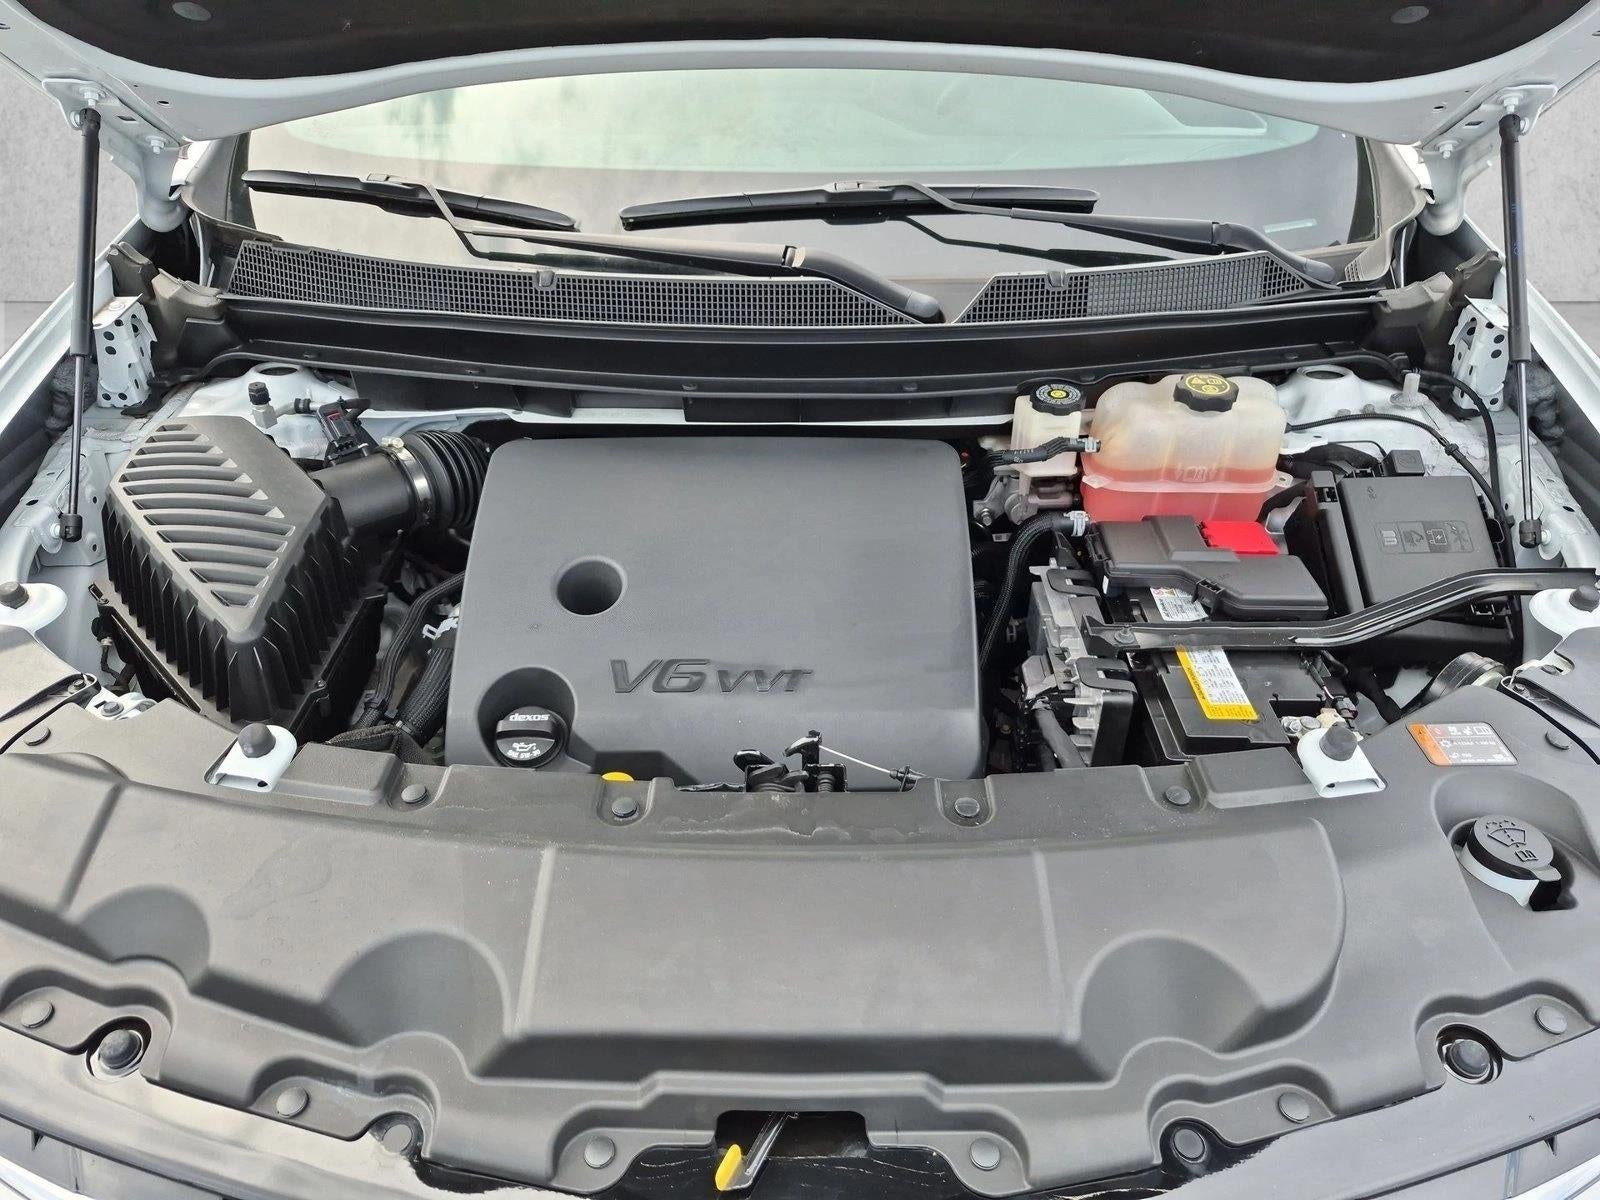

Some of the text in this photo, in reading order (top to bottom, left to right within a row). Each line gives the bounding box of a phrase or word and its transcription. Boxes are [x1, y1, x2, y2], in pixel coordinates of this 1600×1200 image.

[609, 658, 813, 693] V6 VVT
[508, 712, 550, 721] dexos
